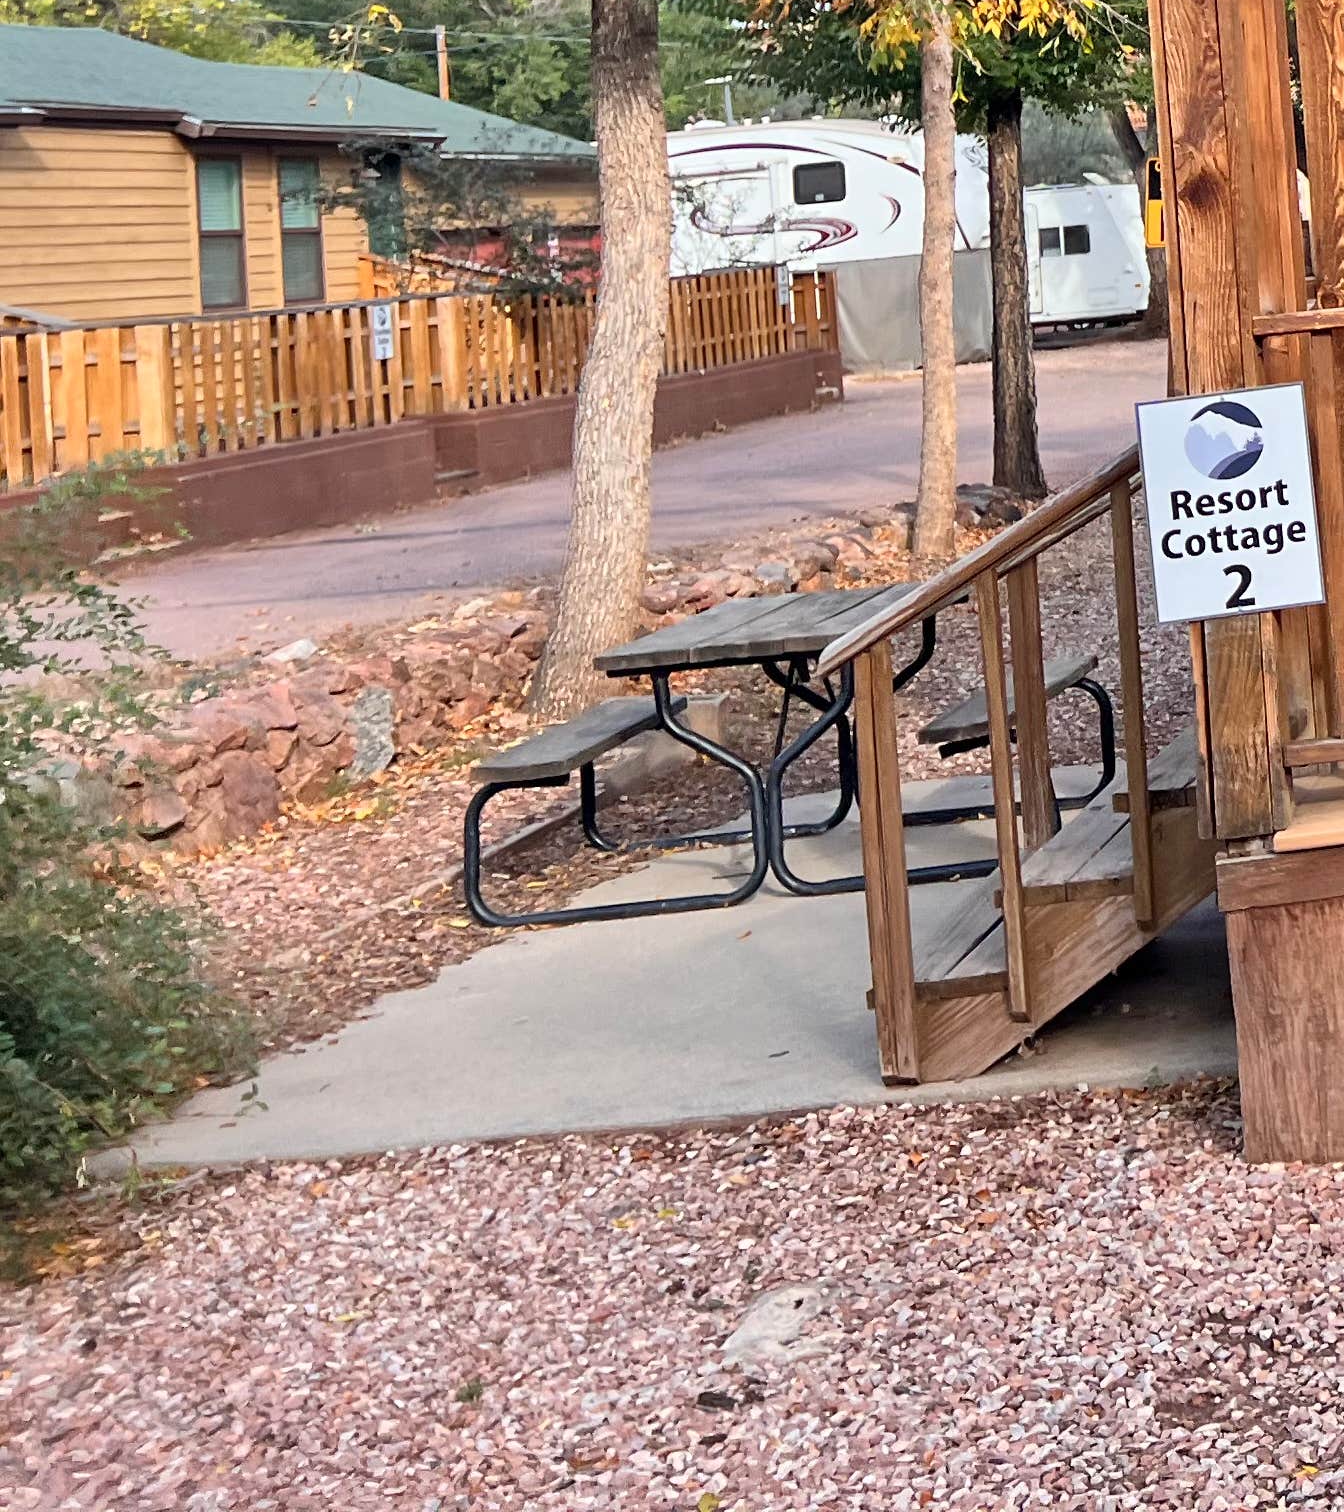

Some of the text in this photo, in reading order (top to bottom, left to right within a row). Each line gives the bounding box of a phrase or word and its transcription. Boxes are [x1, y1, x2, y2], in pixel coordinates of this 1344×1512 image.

[1170, 479, 1289, 520] Resort
[1161, 520, 1306, 559] Cottage
[1223, 564, 1256, 609] 2
